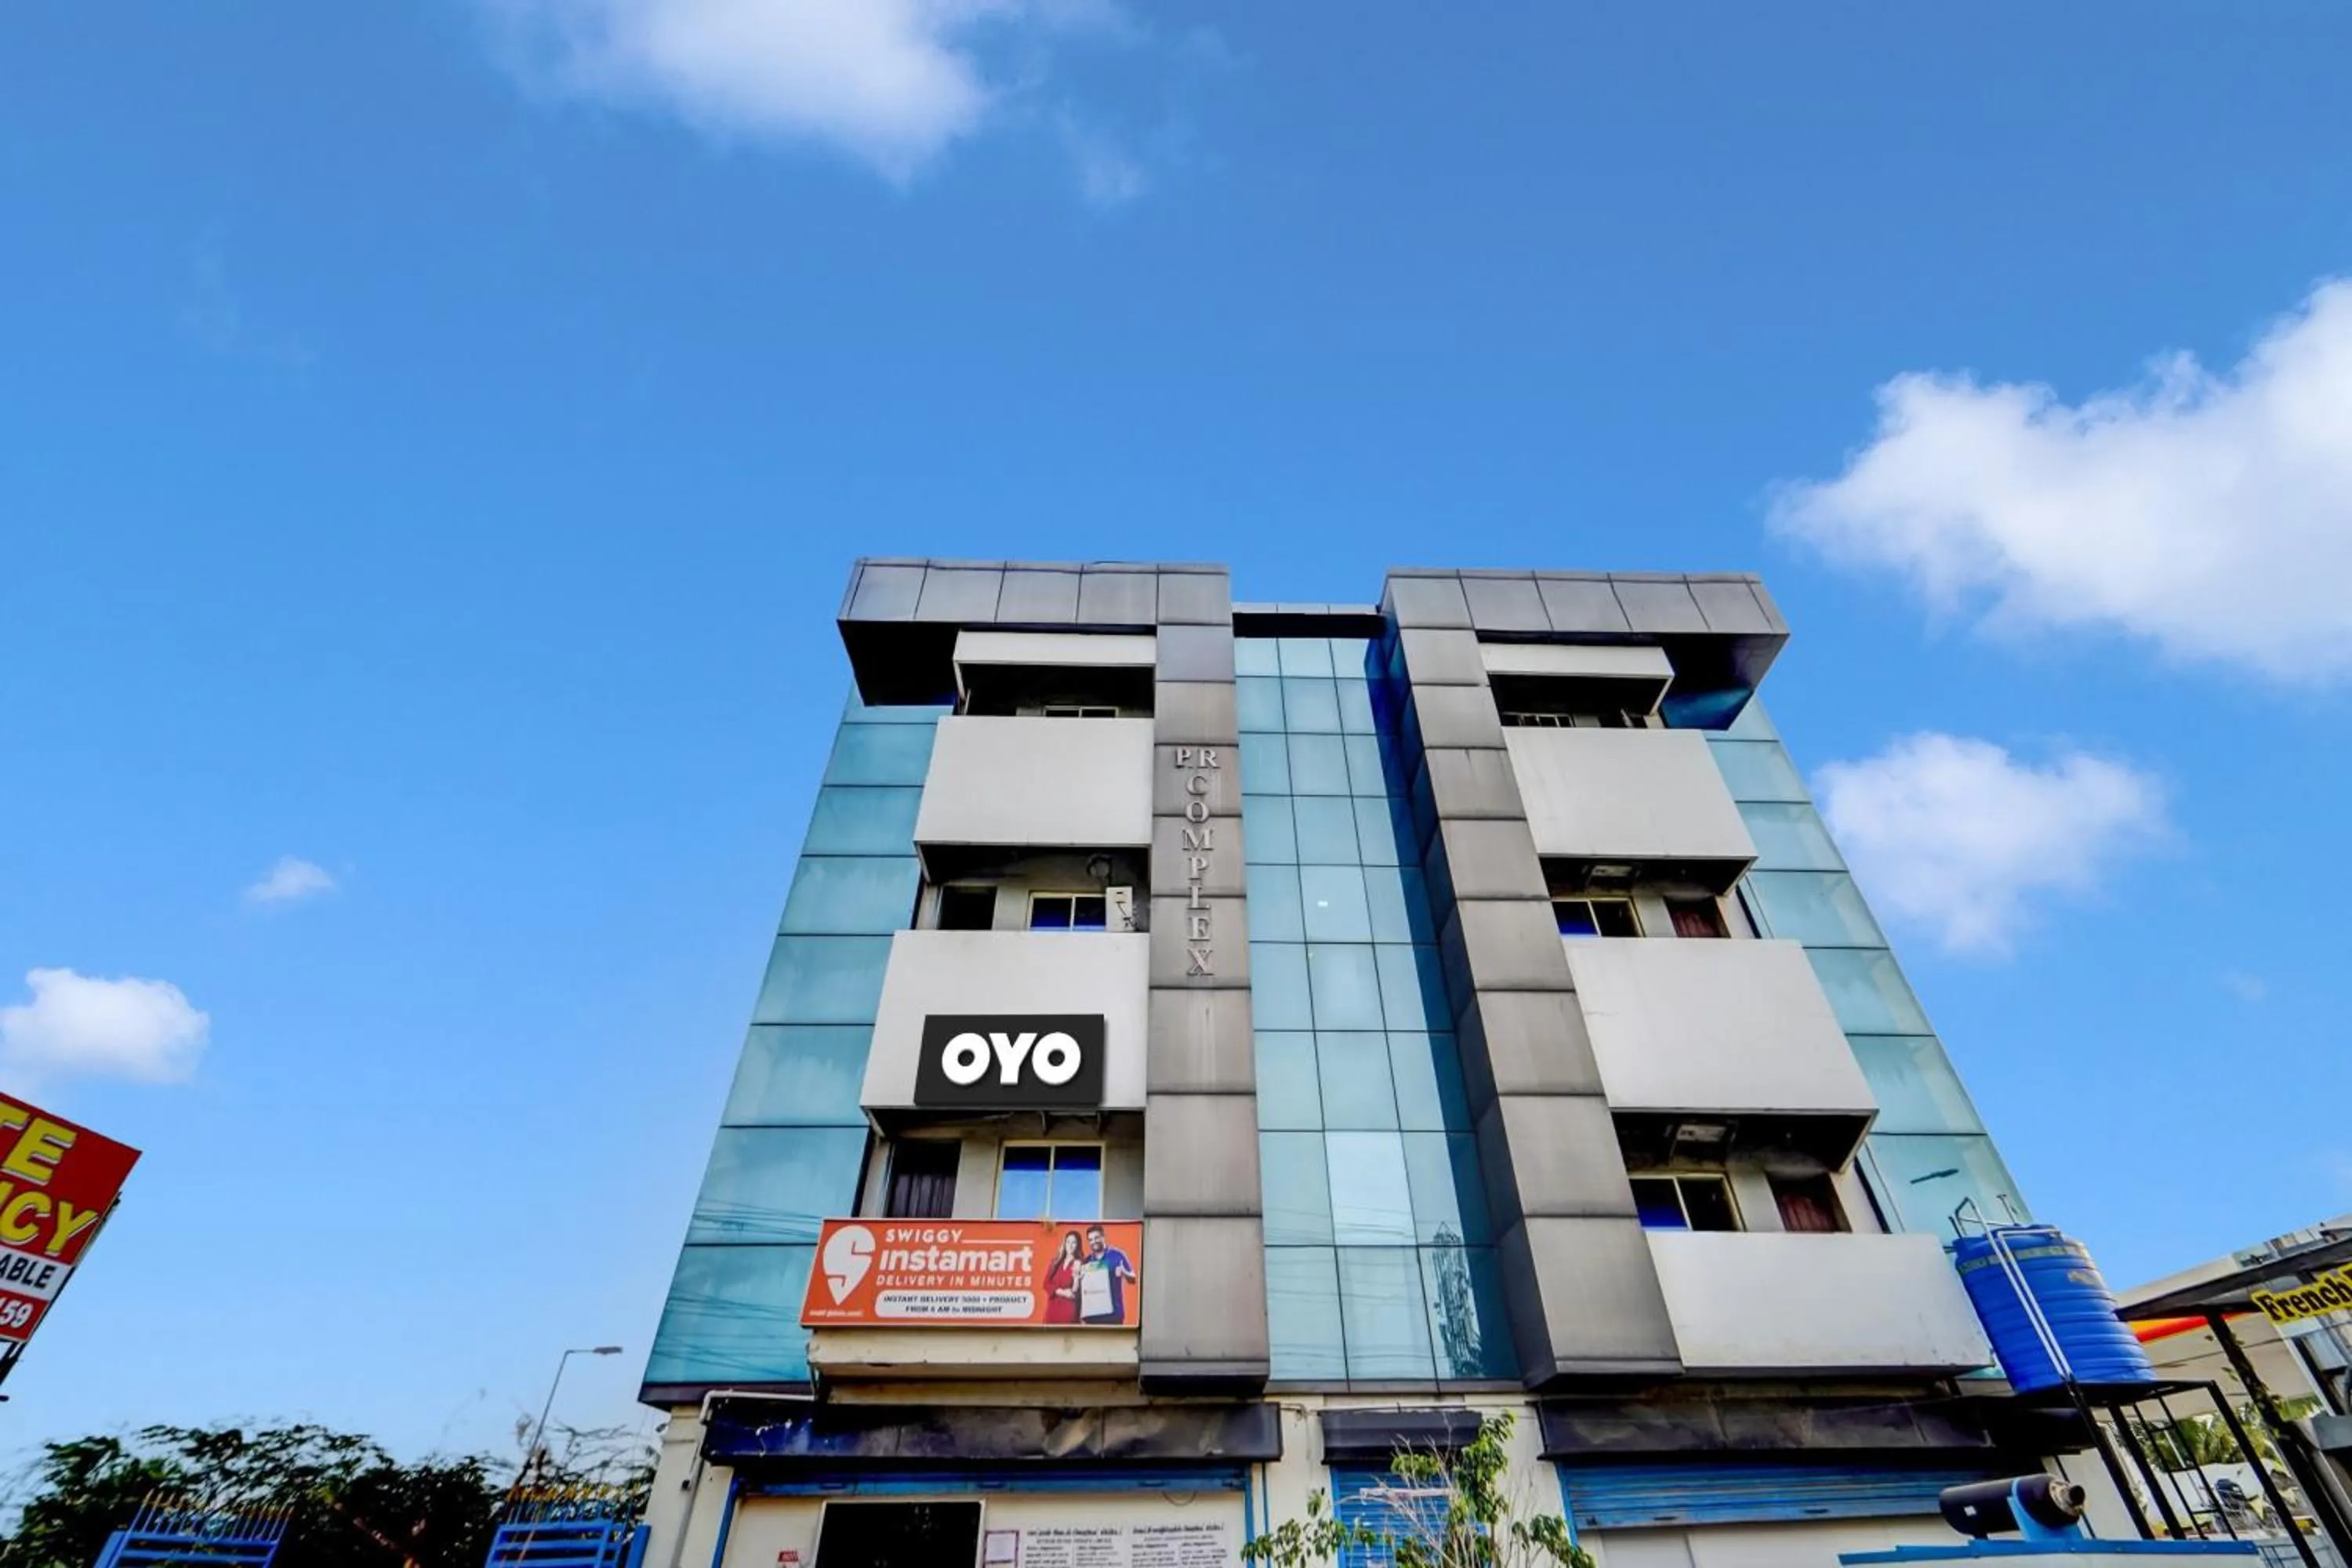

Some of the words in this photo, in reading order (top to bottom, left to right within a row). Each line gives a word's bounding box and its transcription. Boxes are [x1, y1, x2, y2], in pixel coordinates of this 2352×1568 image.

[1175, 747, 1220, 768] PR
[1181, 775, 1214, 976] COMPLEX
[942, 1031, 1081, 1086] OYO
[885, 1229, 963, 1243] SWIGGY
[879, 1245, 1033, 1272] instamart
[876, 1275, 945, 1287] DELIVERY
[949, 1276, 964, 1287] IN
[970, 1276, 1033, 1287] MINUTES
